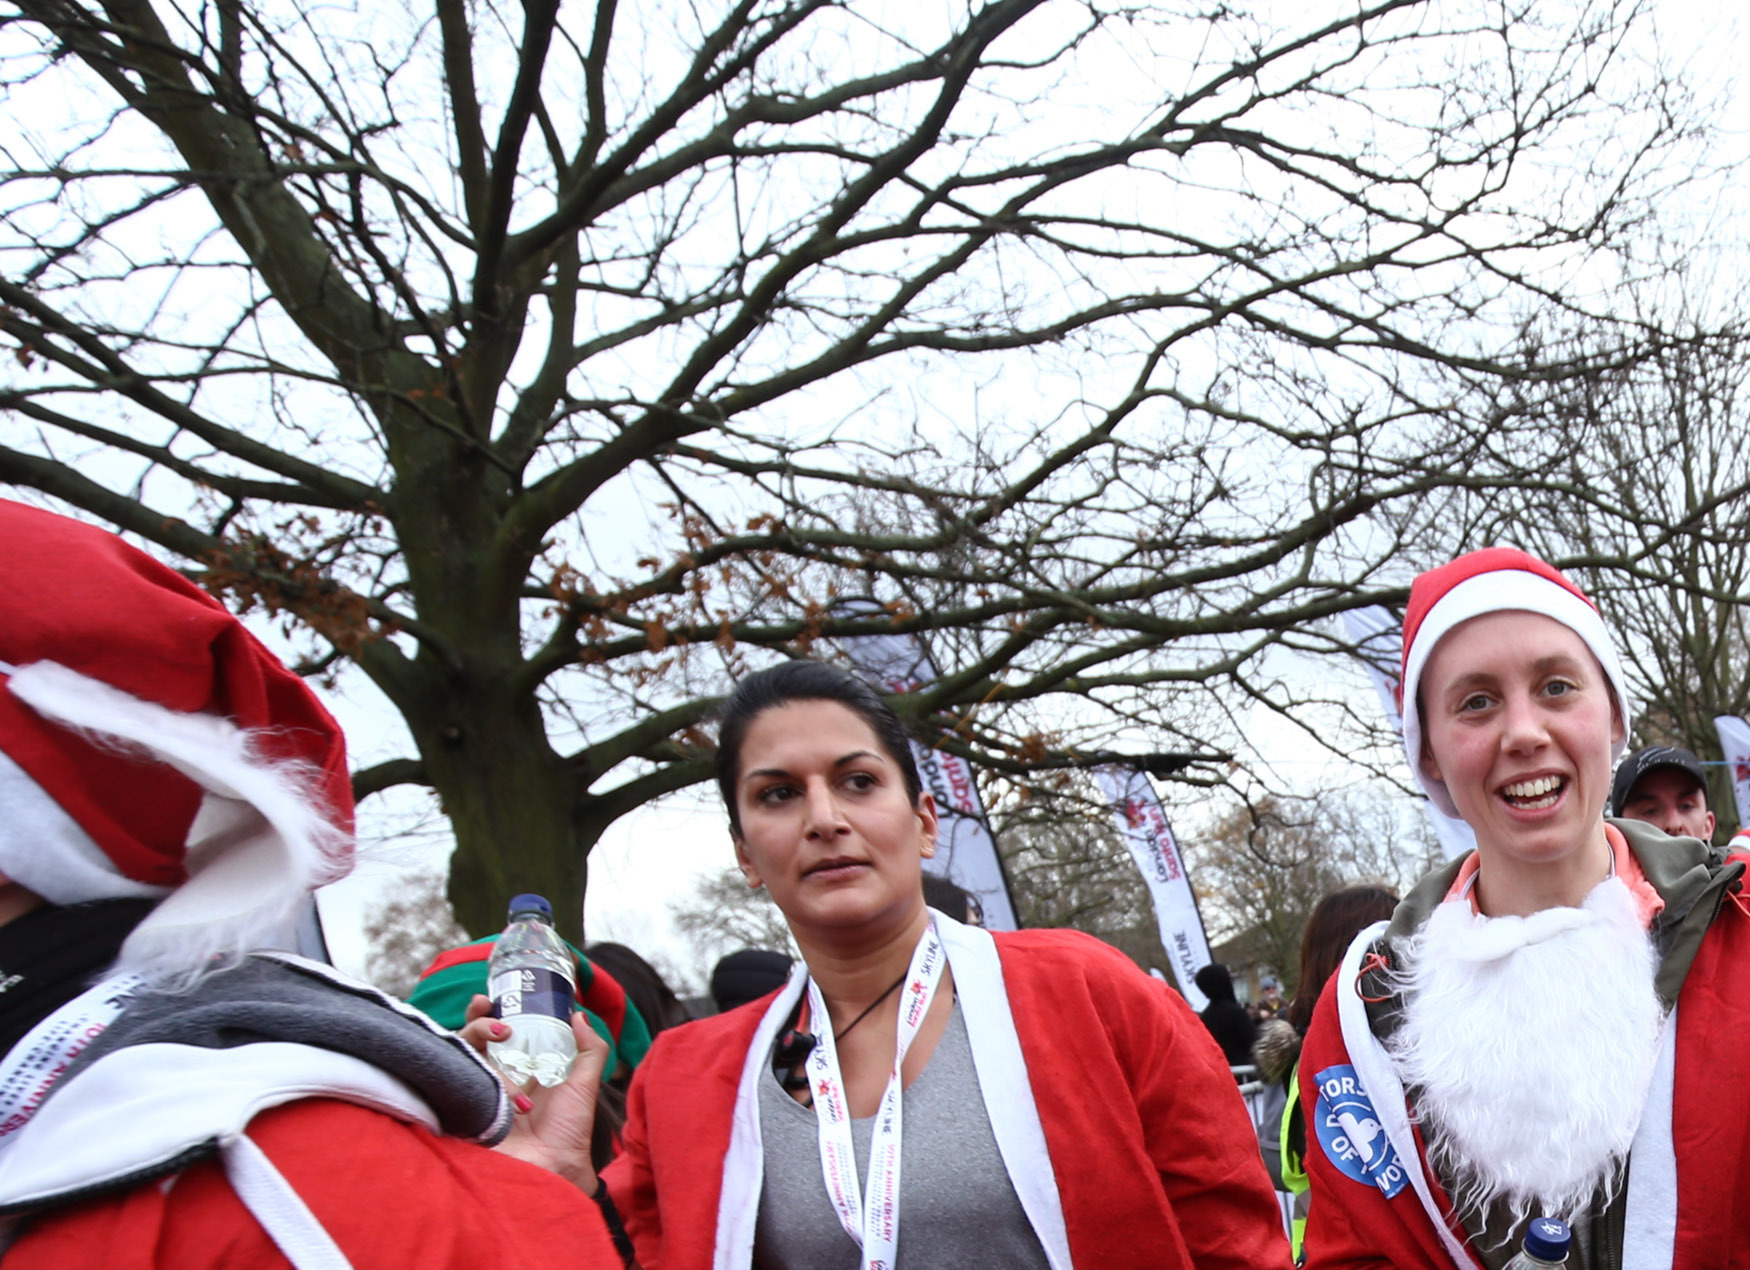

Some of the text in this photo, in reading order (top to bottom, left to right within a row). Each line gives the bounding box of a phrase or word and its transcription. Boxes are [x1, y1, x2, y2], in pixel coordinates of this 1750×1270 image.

[1143, 828, 1169, 884] London
[1159, 836, 1182, 881] Santa
[1172, 929, 1195, 985] SKYLINE
